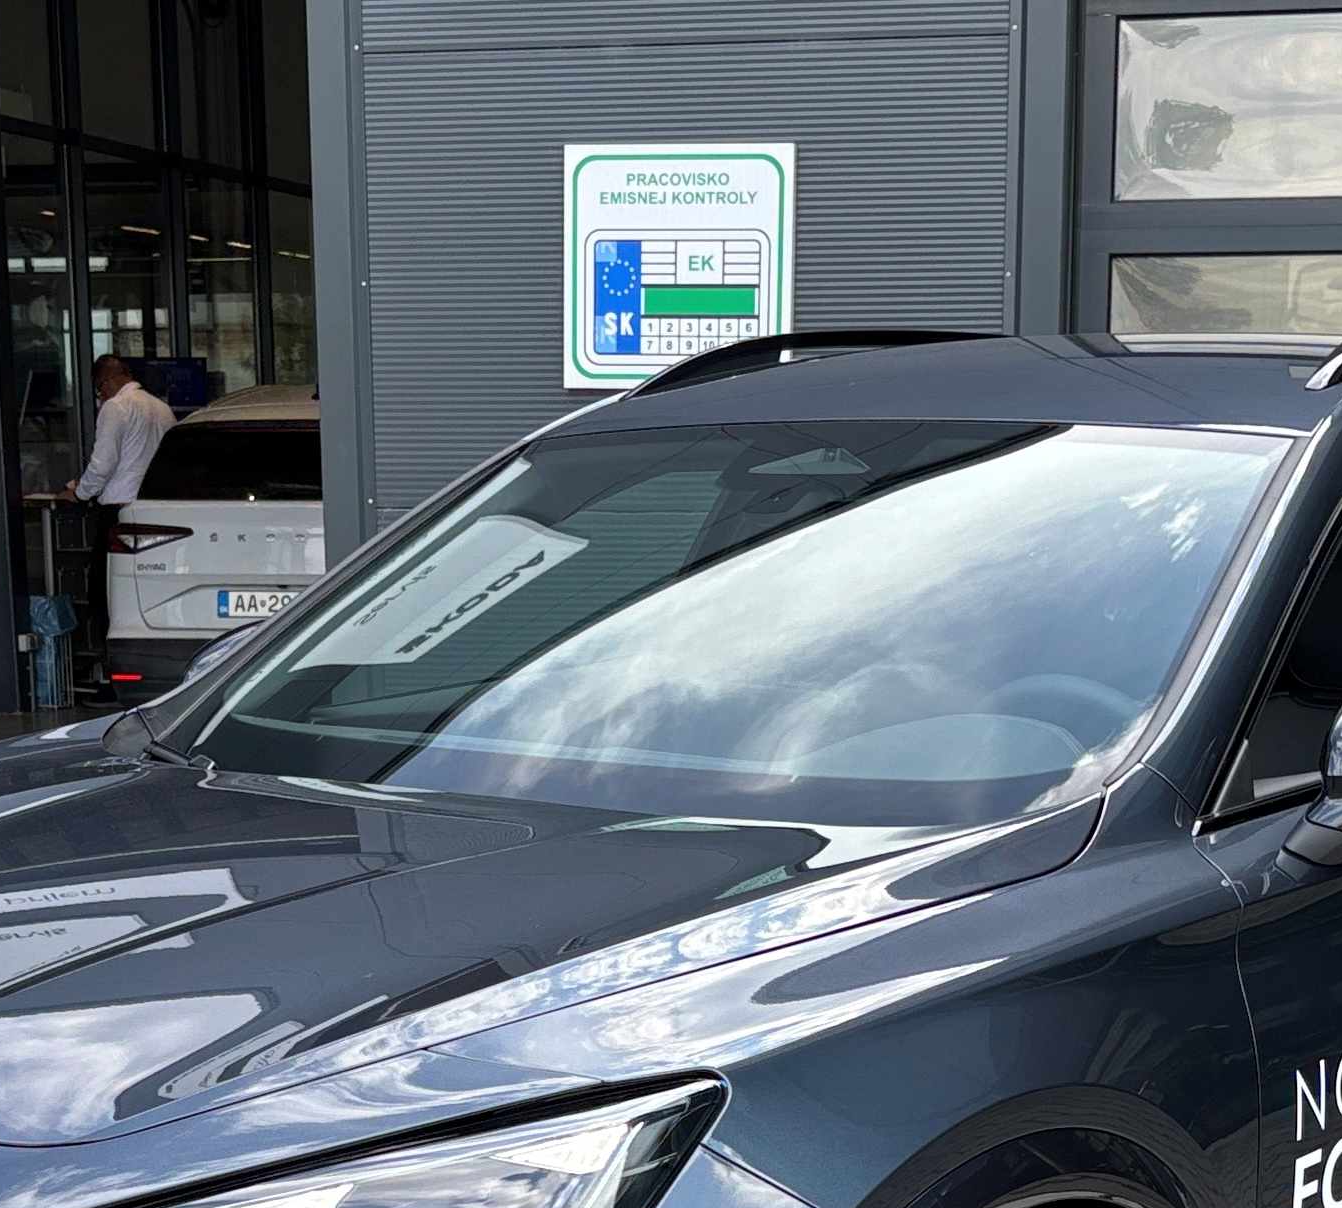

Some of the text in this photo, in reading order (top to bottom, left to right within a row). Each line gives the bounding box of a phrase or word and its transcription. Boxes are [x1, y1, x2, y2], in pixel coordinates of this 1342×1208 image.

[626, 172, 730, 187] PRACOVISKO
[599, 190, 758, 205] EMISNEJ KONTROLY
[688, 255, 715, 272] EK
[603, 311, 635, 337] SK
[234, 594, 259, 613] AA
